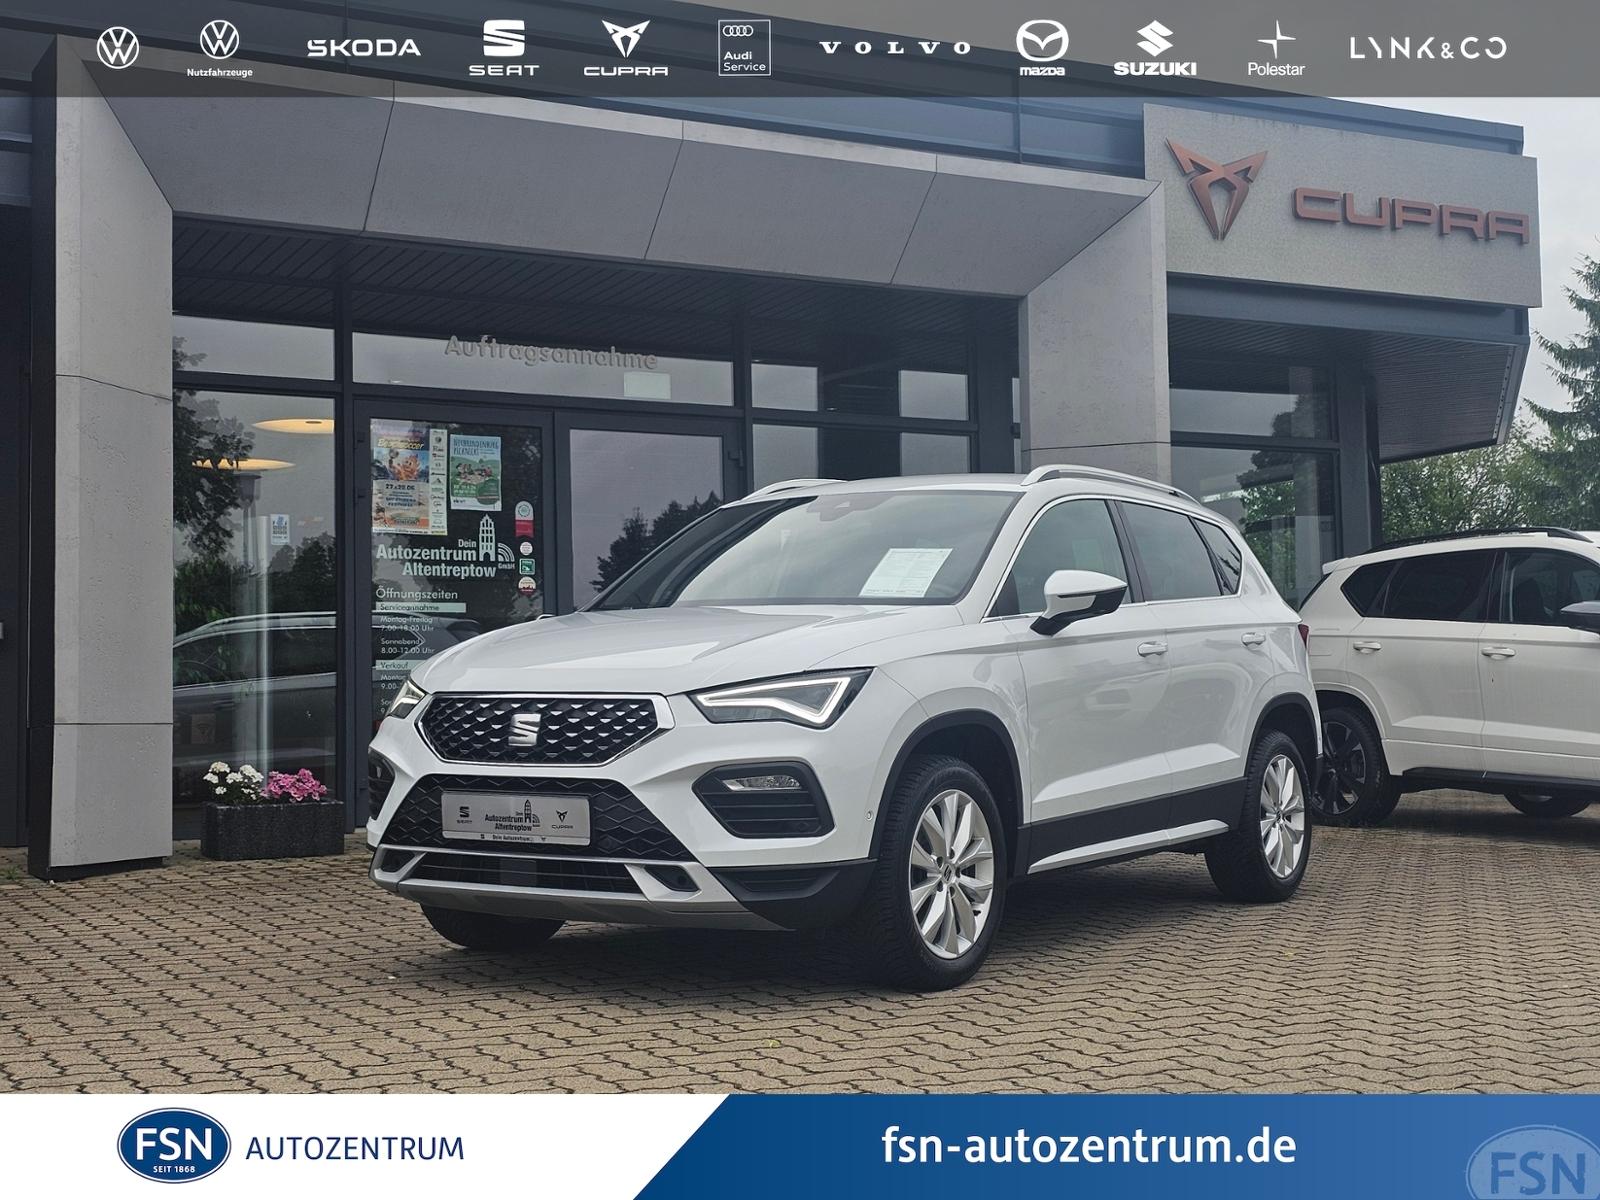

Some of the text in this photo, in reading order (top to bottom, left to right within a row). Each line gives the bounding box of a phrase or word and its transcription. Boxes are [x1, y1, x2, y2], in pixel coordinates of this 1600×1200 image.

[1292, 187, 1530, 244] CUPRA
[444, 334, 658, 369] Auftragsannahme
[457, 539, 477, 549] Dein
[376, 544, 477, 562] Autozentrum
[402, 561, 497, 579] Altentreptow
[375, 585, 459, 601] Öffnungszeiten
[380, 603, 440, 611] Serviceannahme
[421, 624, 435, 632] Uhr
[381, 637, 420, 645] Sonnabend
[380, 661, 409, 669] Verkauf
[484, 813, 524, 823] Autozentrum
[494, 822, 532, 833] Altentreptow
